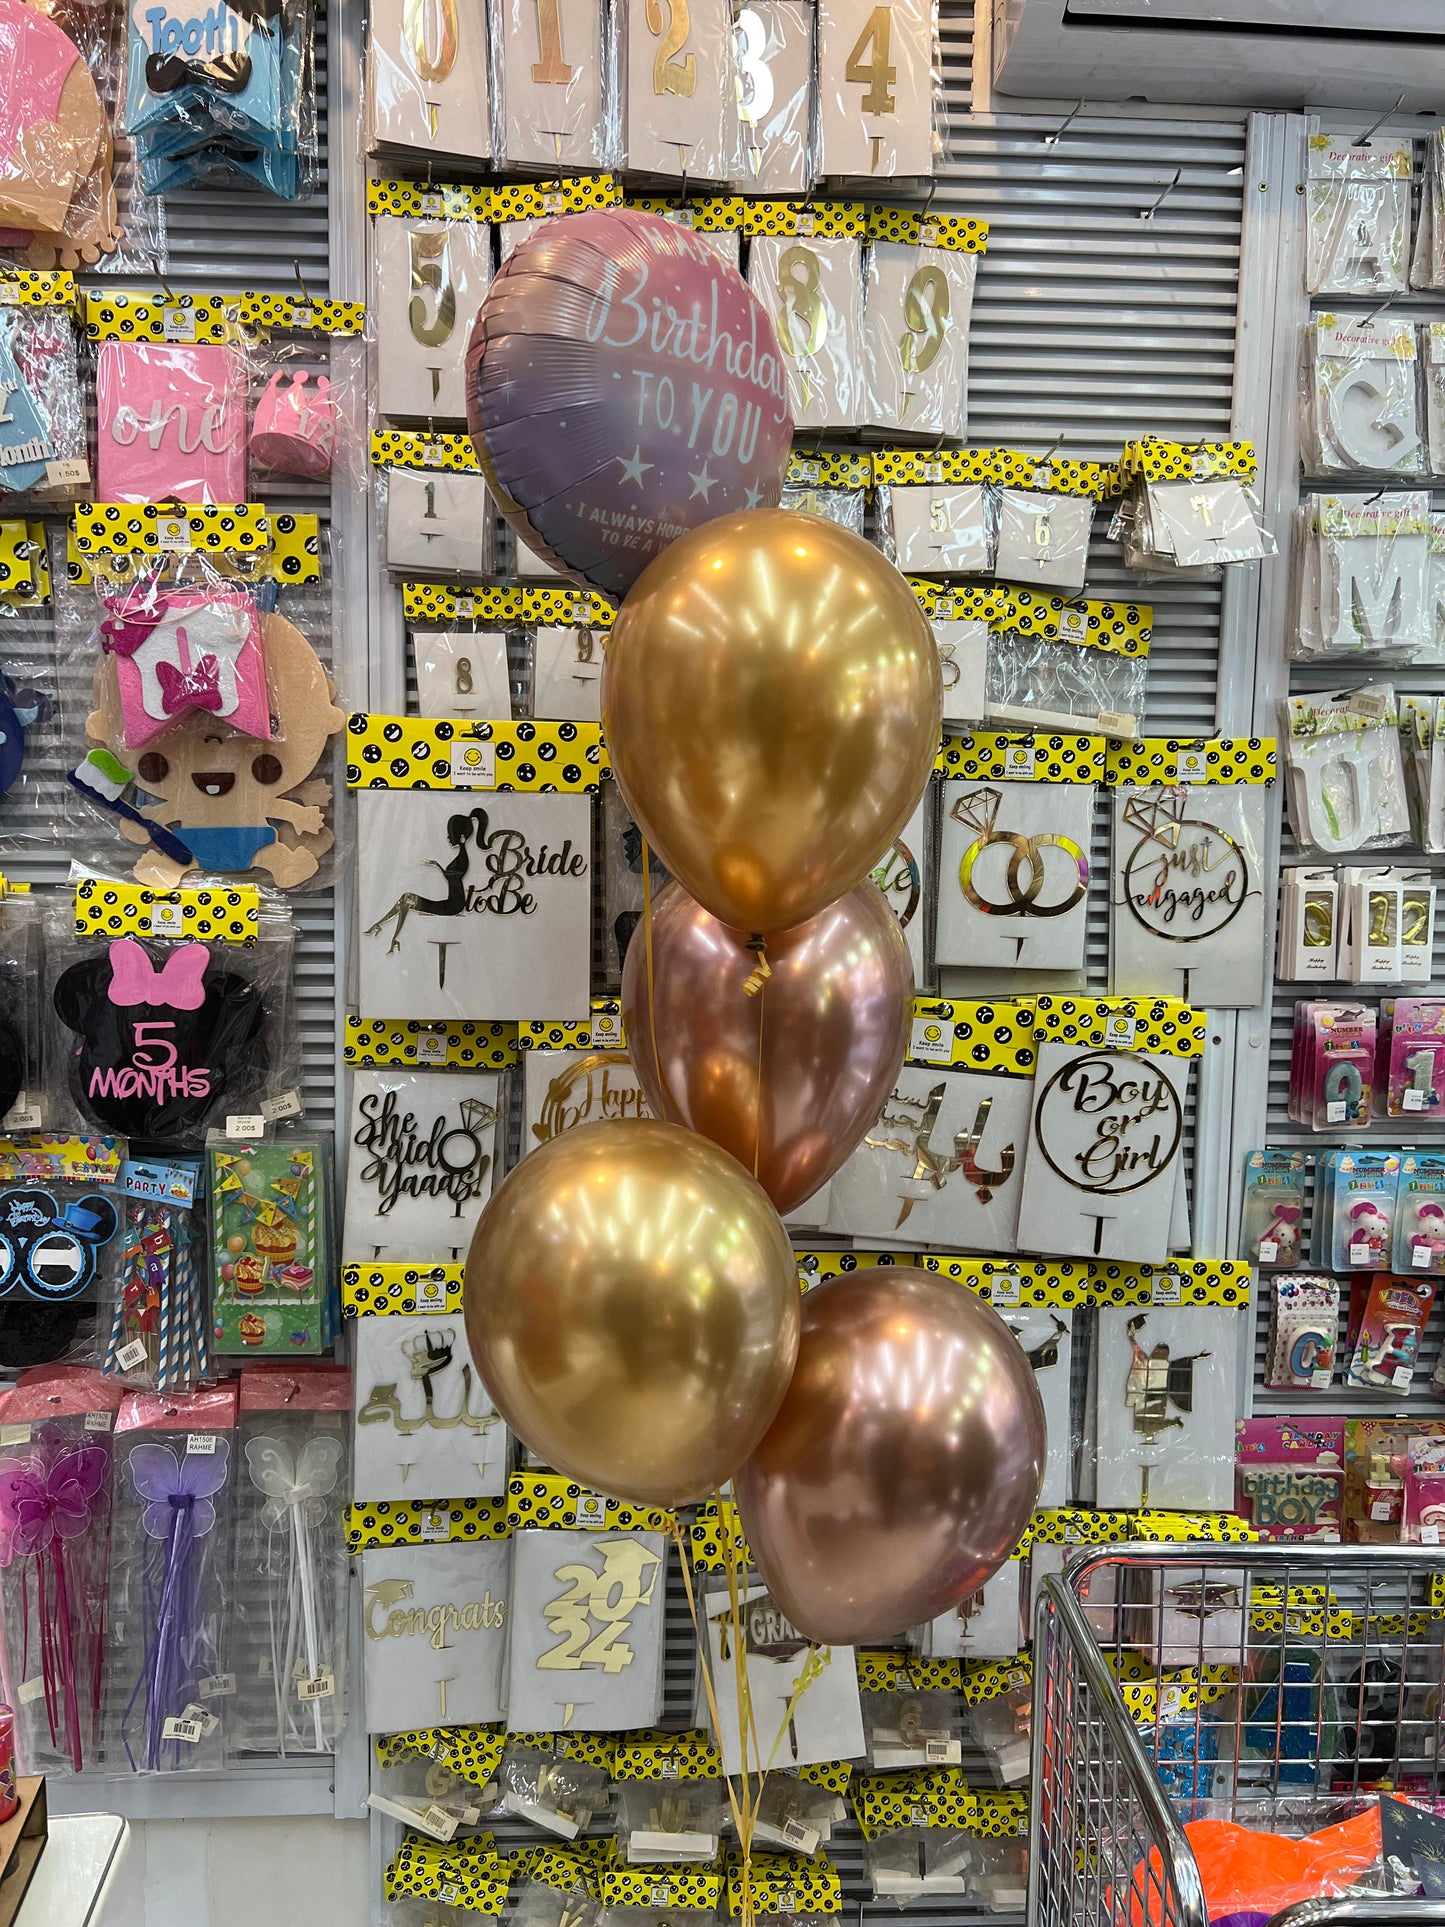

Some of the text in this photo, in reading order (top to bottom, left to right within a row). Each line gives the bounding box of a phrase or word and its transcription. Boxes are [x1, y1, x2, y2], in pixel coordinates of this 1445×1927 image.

[146, 2, 239, 55] Tooth
[645, 0, 696, 98] 2
[732, 8, 774, 122] 3
[845, 6, 897, 117] 4
[408, 230, 457, 348] 5
[777, 246, 828, 358] 8
[586, 258, 788, 424] Birthday
[898, 265, 950, 373] 9
[633, 370, 675, 430] TO
[687, 383, 771, 464] YOU
[1330, 362, 1421, 468] G
[112, 400, 240, 455] one
[424, 481, 437, 518] 1
[589, 508, 654, 534] ALWAYS
[930, 498, 949, 533] 5
[601, 529, 620, 545] TO
[1034, 513, 1053, 546] 6
[1332, 535, 1421, 646] M
[577, 628, 594, 663] 9
[456, 656, 474, 694] 8
[485, 829, 588, 877] Bride
[487, 873, 538, 915] Be
[1118, 870, 1252, 923] engaged
[1368, 895, 1390, 946] 1
[1402, 900, 1428, 946] 2
[132, 1021, 178, 1069] 5
[89, 1065, 211, 1106] MONTHS
[580, 1069, 648, 1118] Happ
[1060, 1060, 1169, 1116] Boy
[354, 1091, 418, 1146] She
[1097, 1115, 1141, 1138] or
[126, 1177, 166, 1196] PARTY
[1075, 1134, 1163, 1188] Girl
[1282, 1432, 1340, 1442] BIRTHDAY
[1245, 1473, 1339, 1499] birthday
[1257, 1494, 1325, 1525] BOY
[365, 1589, 507, 1650] Congrats
[536, 1615, 636, 1675] 24
[425, 1763, 450, 1797] G
